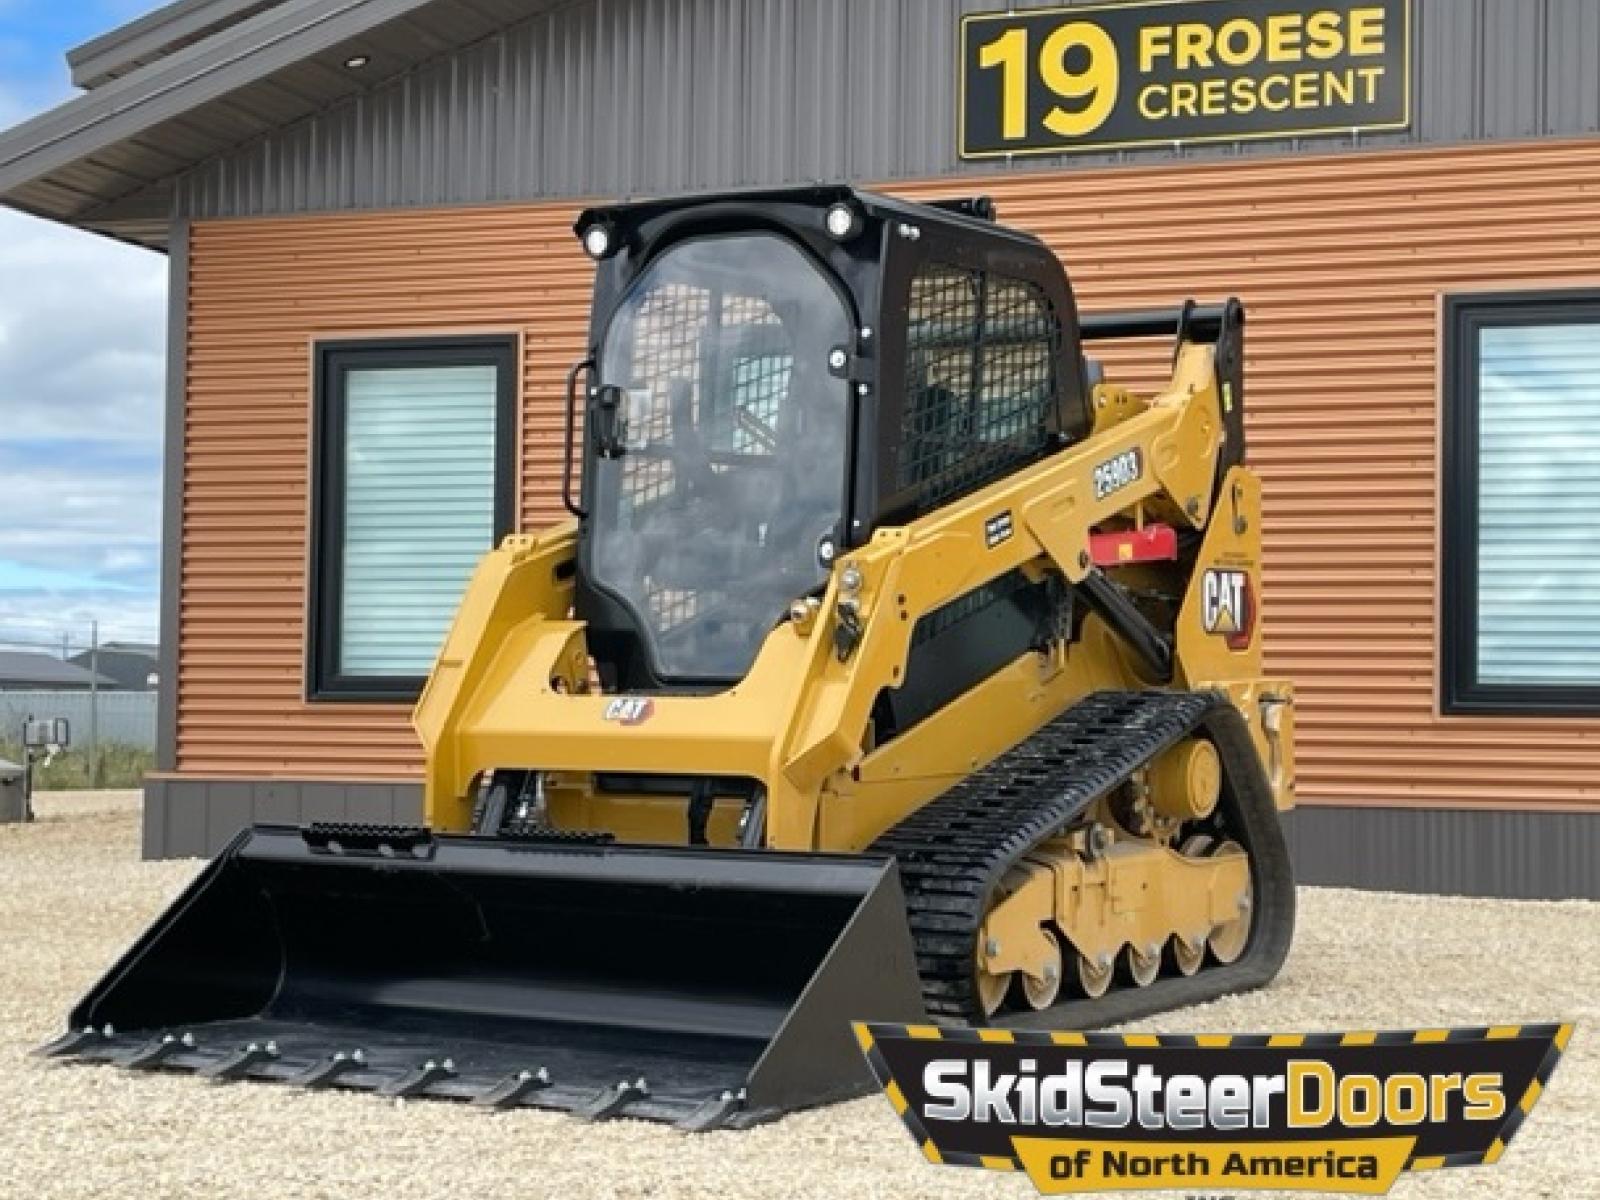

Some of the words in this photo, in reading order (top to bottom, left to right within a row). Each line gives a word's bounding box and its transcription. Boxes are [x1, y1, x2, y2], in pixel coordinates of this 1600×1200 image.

[1139, 7, 1385, 73] FROESE
[978, 20, 1120, 140] 19
[1138, 67, 1386, 120] CRESCENT
[1204, 571, 1245, 632] CAT
[605, 696, 649, 720] CAT
